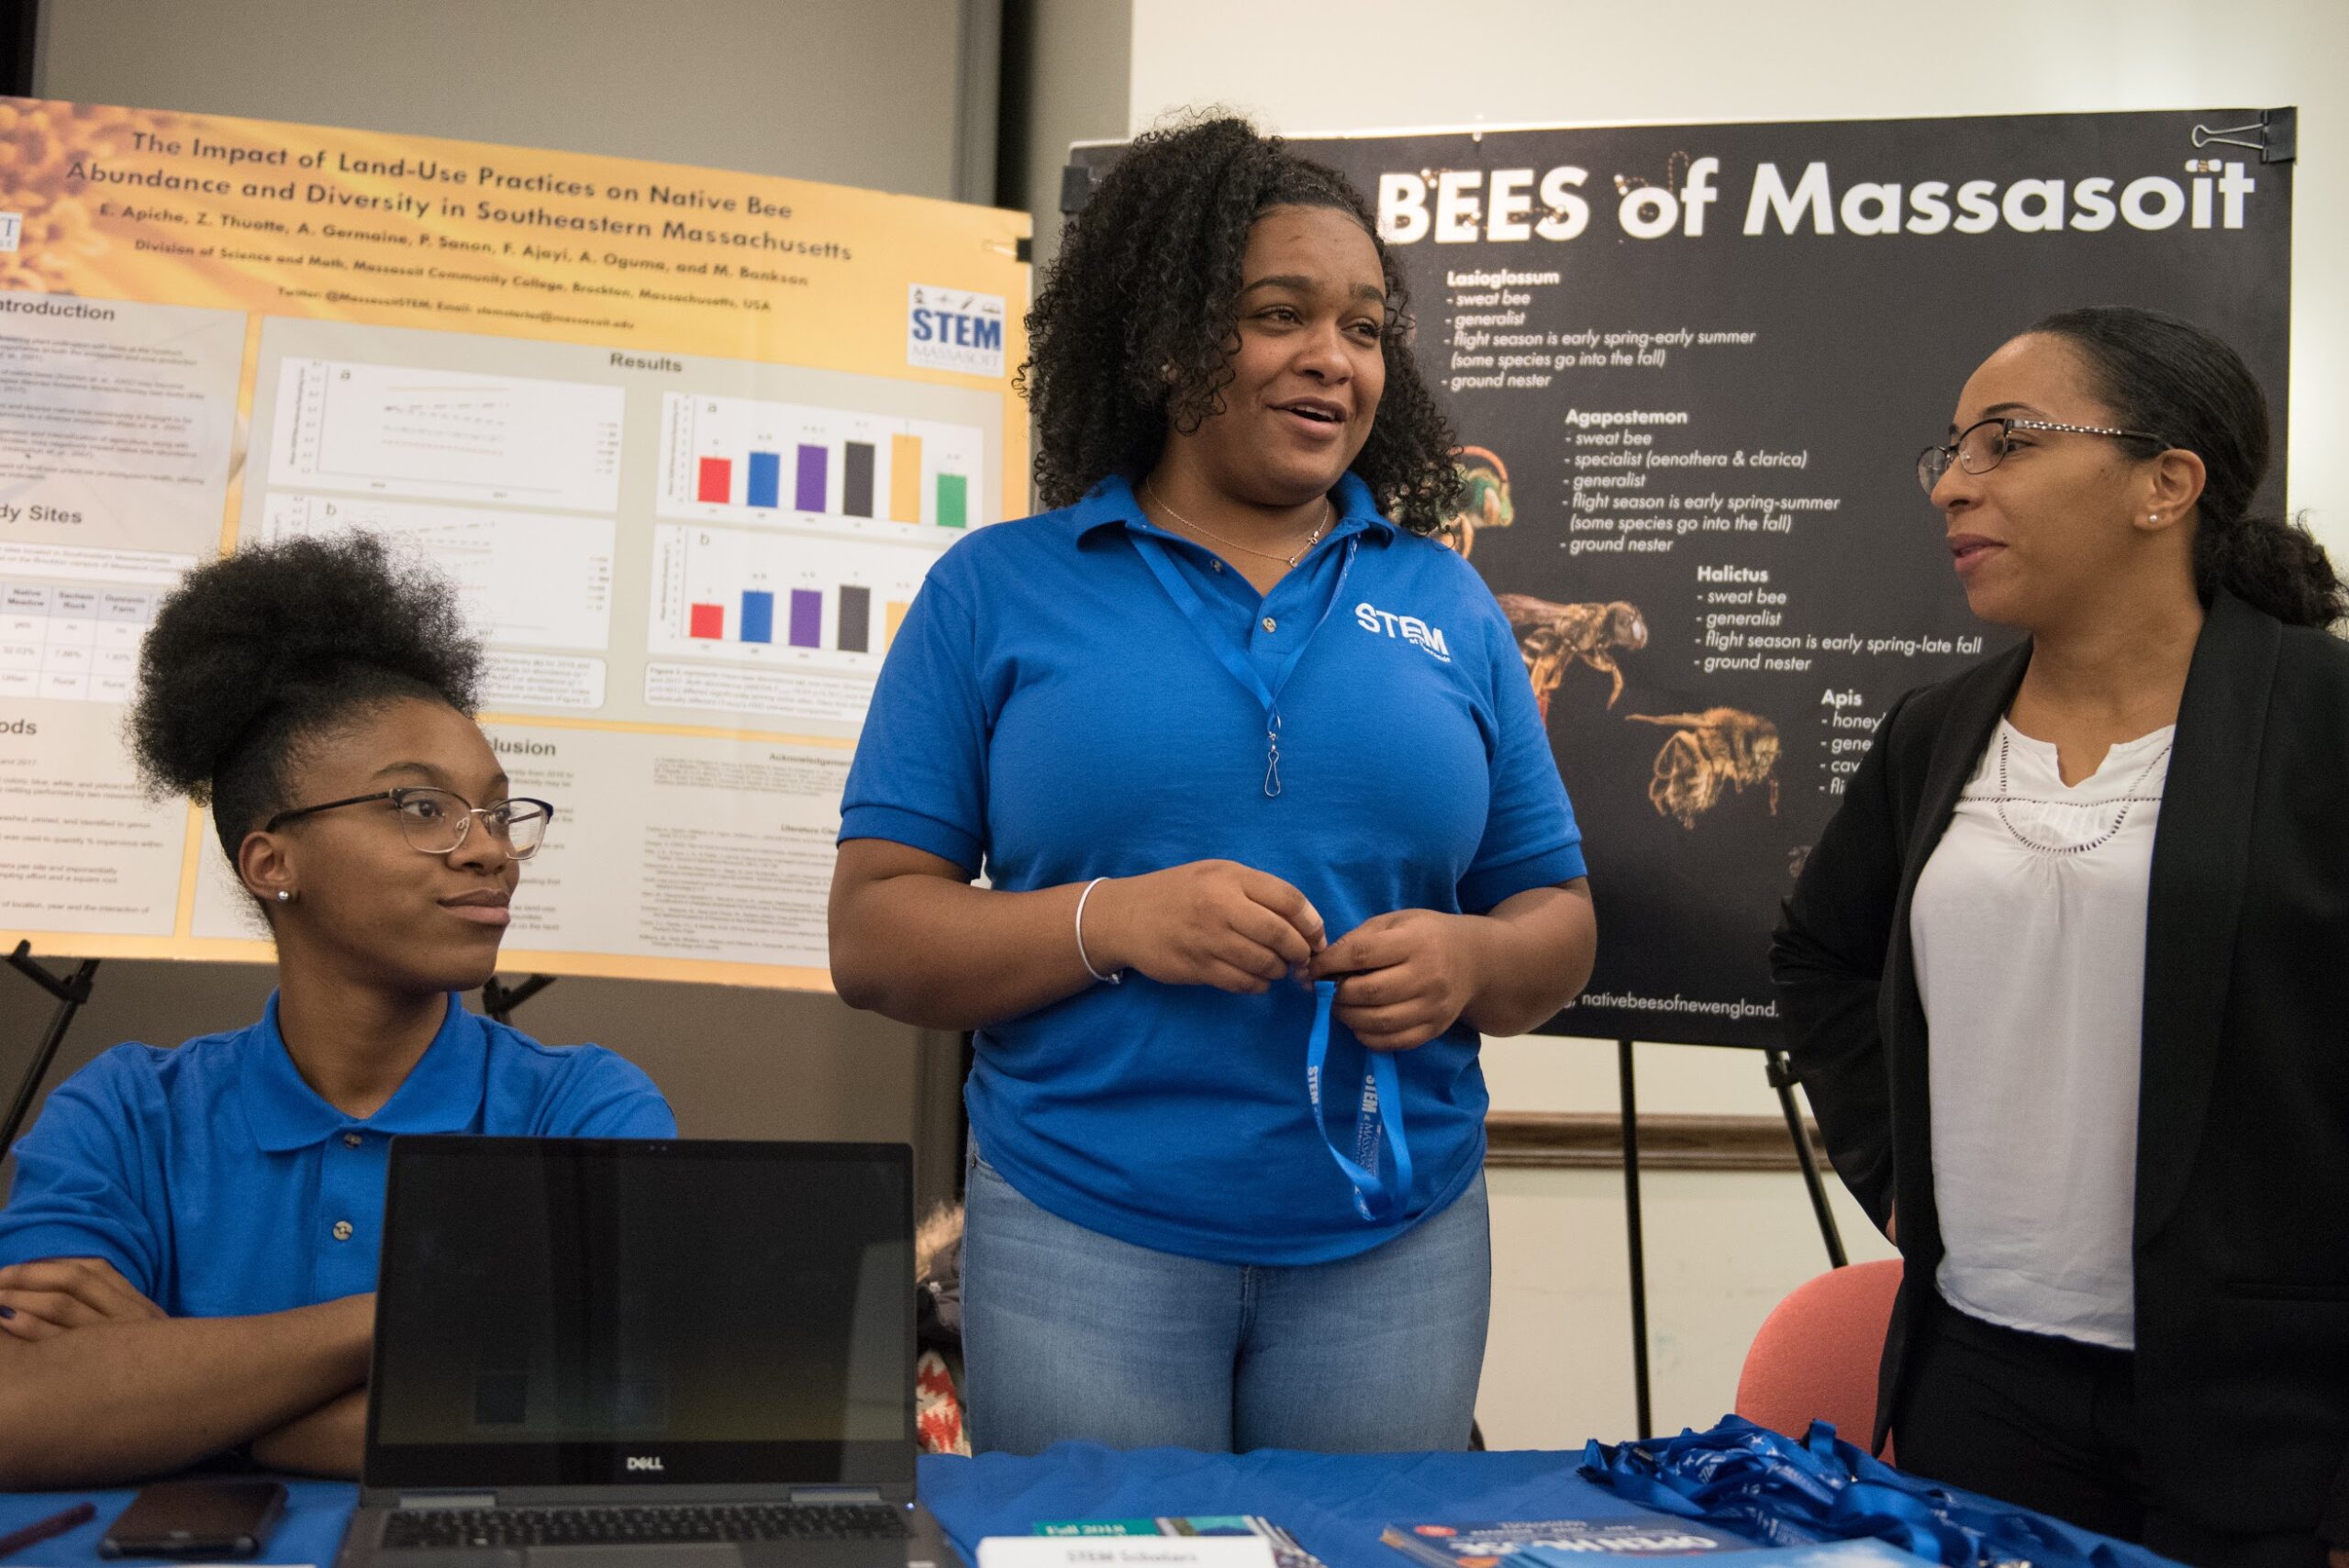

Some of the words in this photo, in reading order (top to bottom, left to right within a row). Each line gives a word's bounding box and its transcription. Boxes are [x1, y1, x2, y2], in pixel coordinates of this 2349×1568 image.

[132, 133, 181, 157] The
[193, 139, 287, 169] Impact
[299, 150, 326, 169] of
[339, 153, 467, 183] Land-Use
[478, 167, 595, 197] Practices
[607, 185, 639, 202] on
[650, 185, 737, 212] Native
[748, 196, 792, 218] Bee
[66, 161, 231, 195] Abundance
[242, 179, 295, 200] and
[306, 185, 430, 217] Diversity
[443, 198, 465, 217] in
[477, 201, 651, 237] Southeastern
[663, 222, 852, 261] Massachusetts
[1376, 166, 1589, 244] BEES
[1617, 157, 1719, 239] of
[135, 239, 195, 255] Division
[676, 261, 707, 274] and
[1447, 269, 1560, 290] Lasioglossum
[1456, 293, 1500, 306] sweat
[1502, 290, 1531, 306] bee
[912, 307, 1001, 351] STEM
[1454, 309, 1526, 330] generalist
[1453, 328, 1490, 350] flight
[1493, 335, 1543, 347] season
[1547, 331, 1558, 346] is
[1562, 329, 1600, 349] early
[1603, 328, 1694, 350] spring-early
[1698, 332, 1756, 344] summer
[609, 352, 683, 373] Results
[1451, 351, 1494, 370] (some
[1497, 352, 1551, 371] species
[1554, 355, 1575, 371] go
[1579, 351, 1607, 366] into
[1610, 350, 1633, 366] the
[1637, 349, 1665, 368] fall)
[1451, 371, 1505, 393] ground
[1508, 374, 1552, 387] nester
[1564, 408, 1687, 428] Agapostemon
[1575, 432, 1620, 446] sweat
[1622, 430, 1652, 445] bee
[1575, 450, 1642, 470] specialist
[1646, 450, 1728, 469] (oenothera
[1732, 450, 1745, 466] &
[1750, 450, 1808, 469] clarica)
[1573, 471, 1646, 492] generalist
[1573, 491, 1609, 513] flight
[1612, 497, 1664, 509] season
[1669, 495, 1680, 509] is
[1684, 493, 1723, 513] early
[1728, 495, 1840, 515] spring-summer
[29, 505, 83, 525] Sites
[1570, 514, 1614, 532] (some
[1618, 516, 1673, 534] species
[1676, 519, 1698, 534] go
[1702, 516, 1731, 530] into
[1735, 514, 1758, 531] the
[1763, 513, 1791, 534] fall)
[699, 532, 710, 547] b
[1570, 535, 1625, 555] ground
[1628, 539, 1674, 551] nester
[1698, 565, 1768, 583] Halictus
[1708, 590, 1753, 604] sweat
[1756, 588, 1787, 605] bee
[1355, 602, 1450, 657] STEM
[1707, 609, 1782, 630] generalist
[1706, 630, 1744, 651] flight
[1747, 636, 1800, 649] season
[1806, 634, 1817, 649] is
[1821, 633, 1863, 654] early
[1867, 635, 1952, 655] spring-late
[1956, 636, 1982, 654] fall
[1704, 653, 1761, 673] ground
[1765, 657, 1811, 671] nester
[1820, 688, 1863, 709] Apis
[1832, 711, 1887, 734] honey
[1831, 738, 1874, 754] gene
[1831, 758, 1863, 773] cav
[1307, 1064, 1319, 1105] STEM
[627, 1455, 664, 1471] DELL
